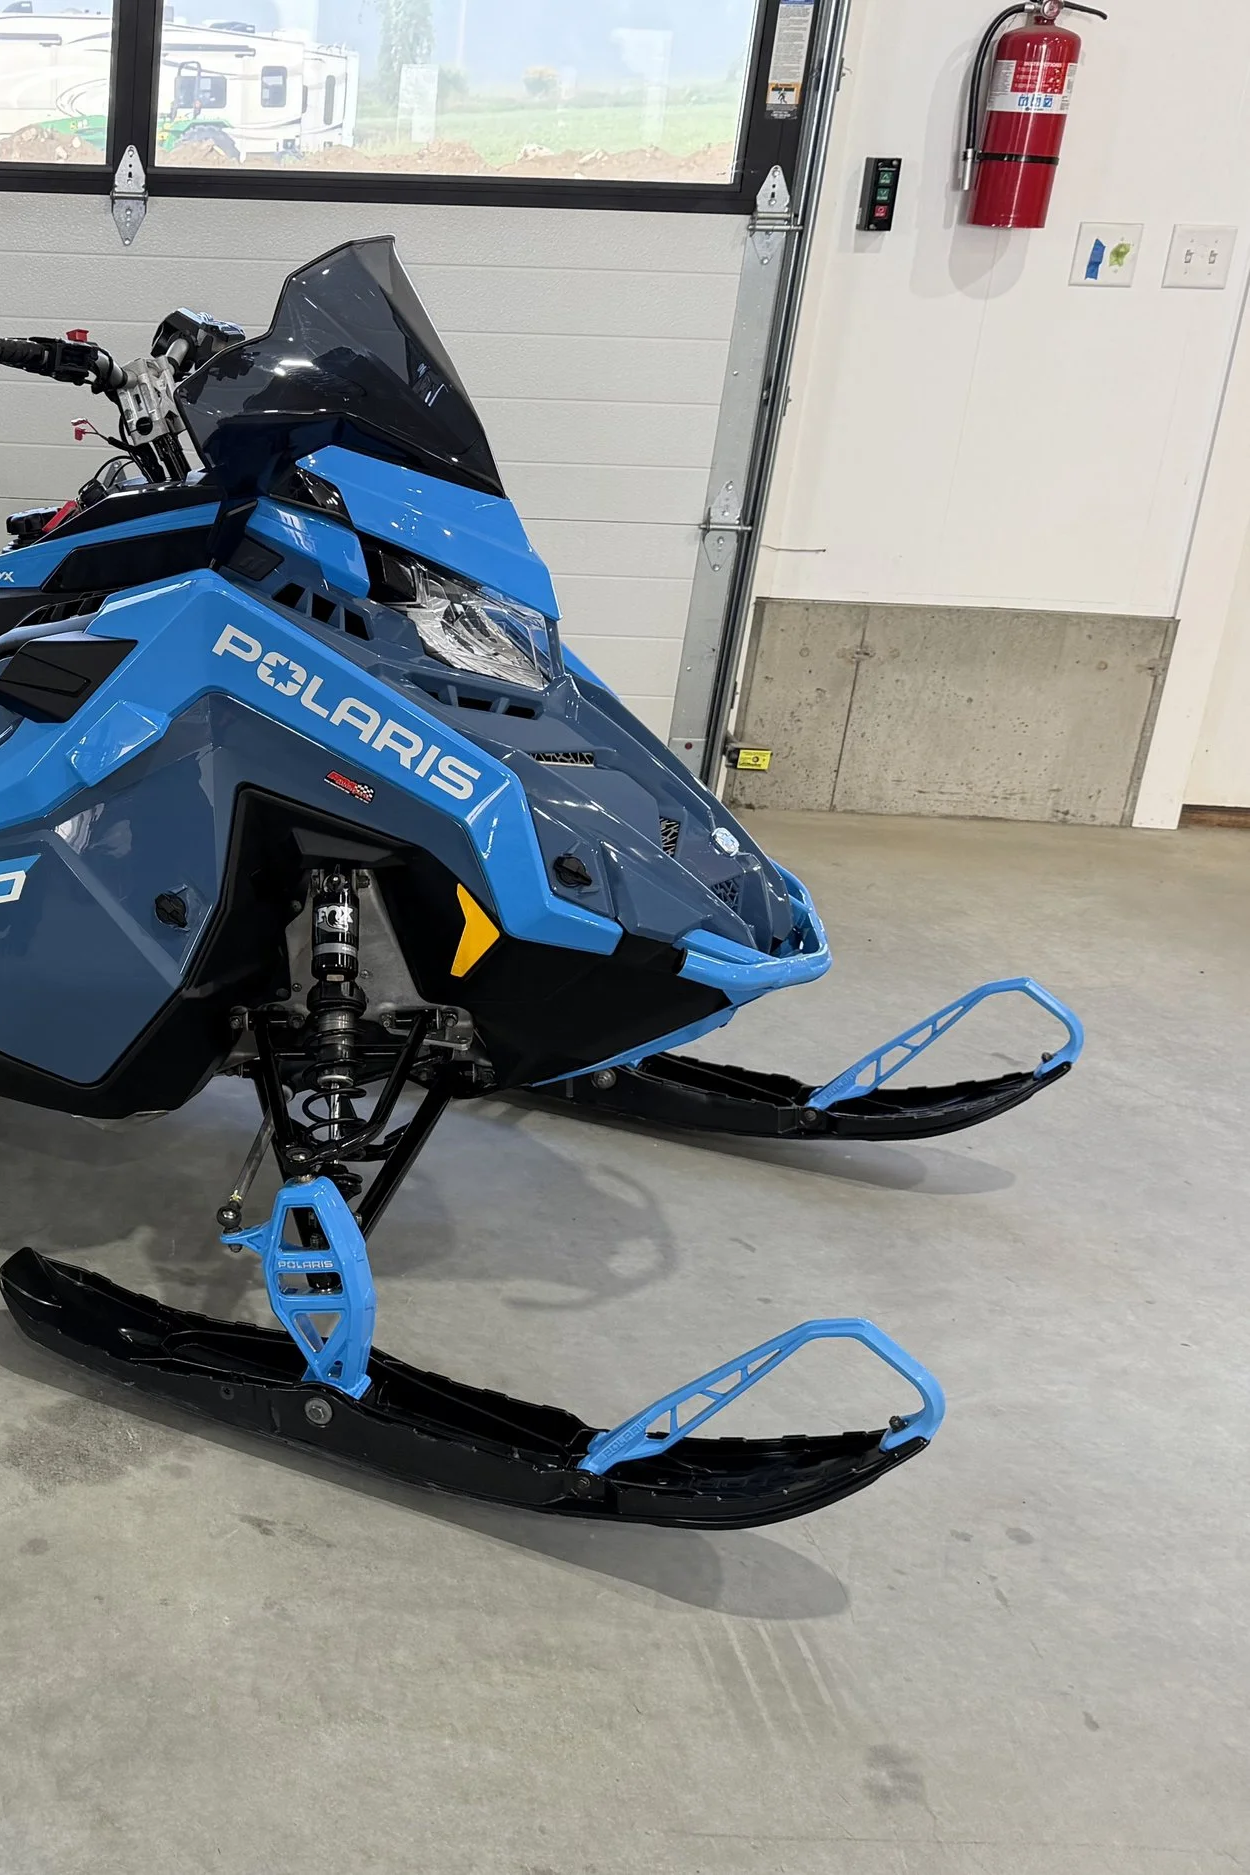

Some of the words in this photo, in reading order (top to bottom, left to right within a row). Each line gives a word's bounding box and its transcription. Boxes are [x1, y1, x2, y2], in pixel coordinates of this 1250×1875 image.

[212, 624, 481, 800] POLARIS
[317, 905, 354, 931] FOX
[277, 1260, 334, 1268] POLARIS
